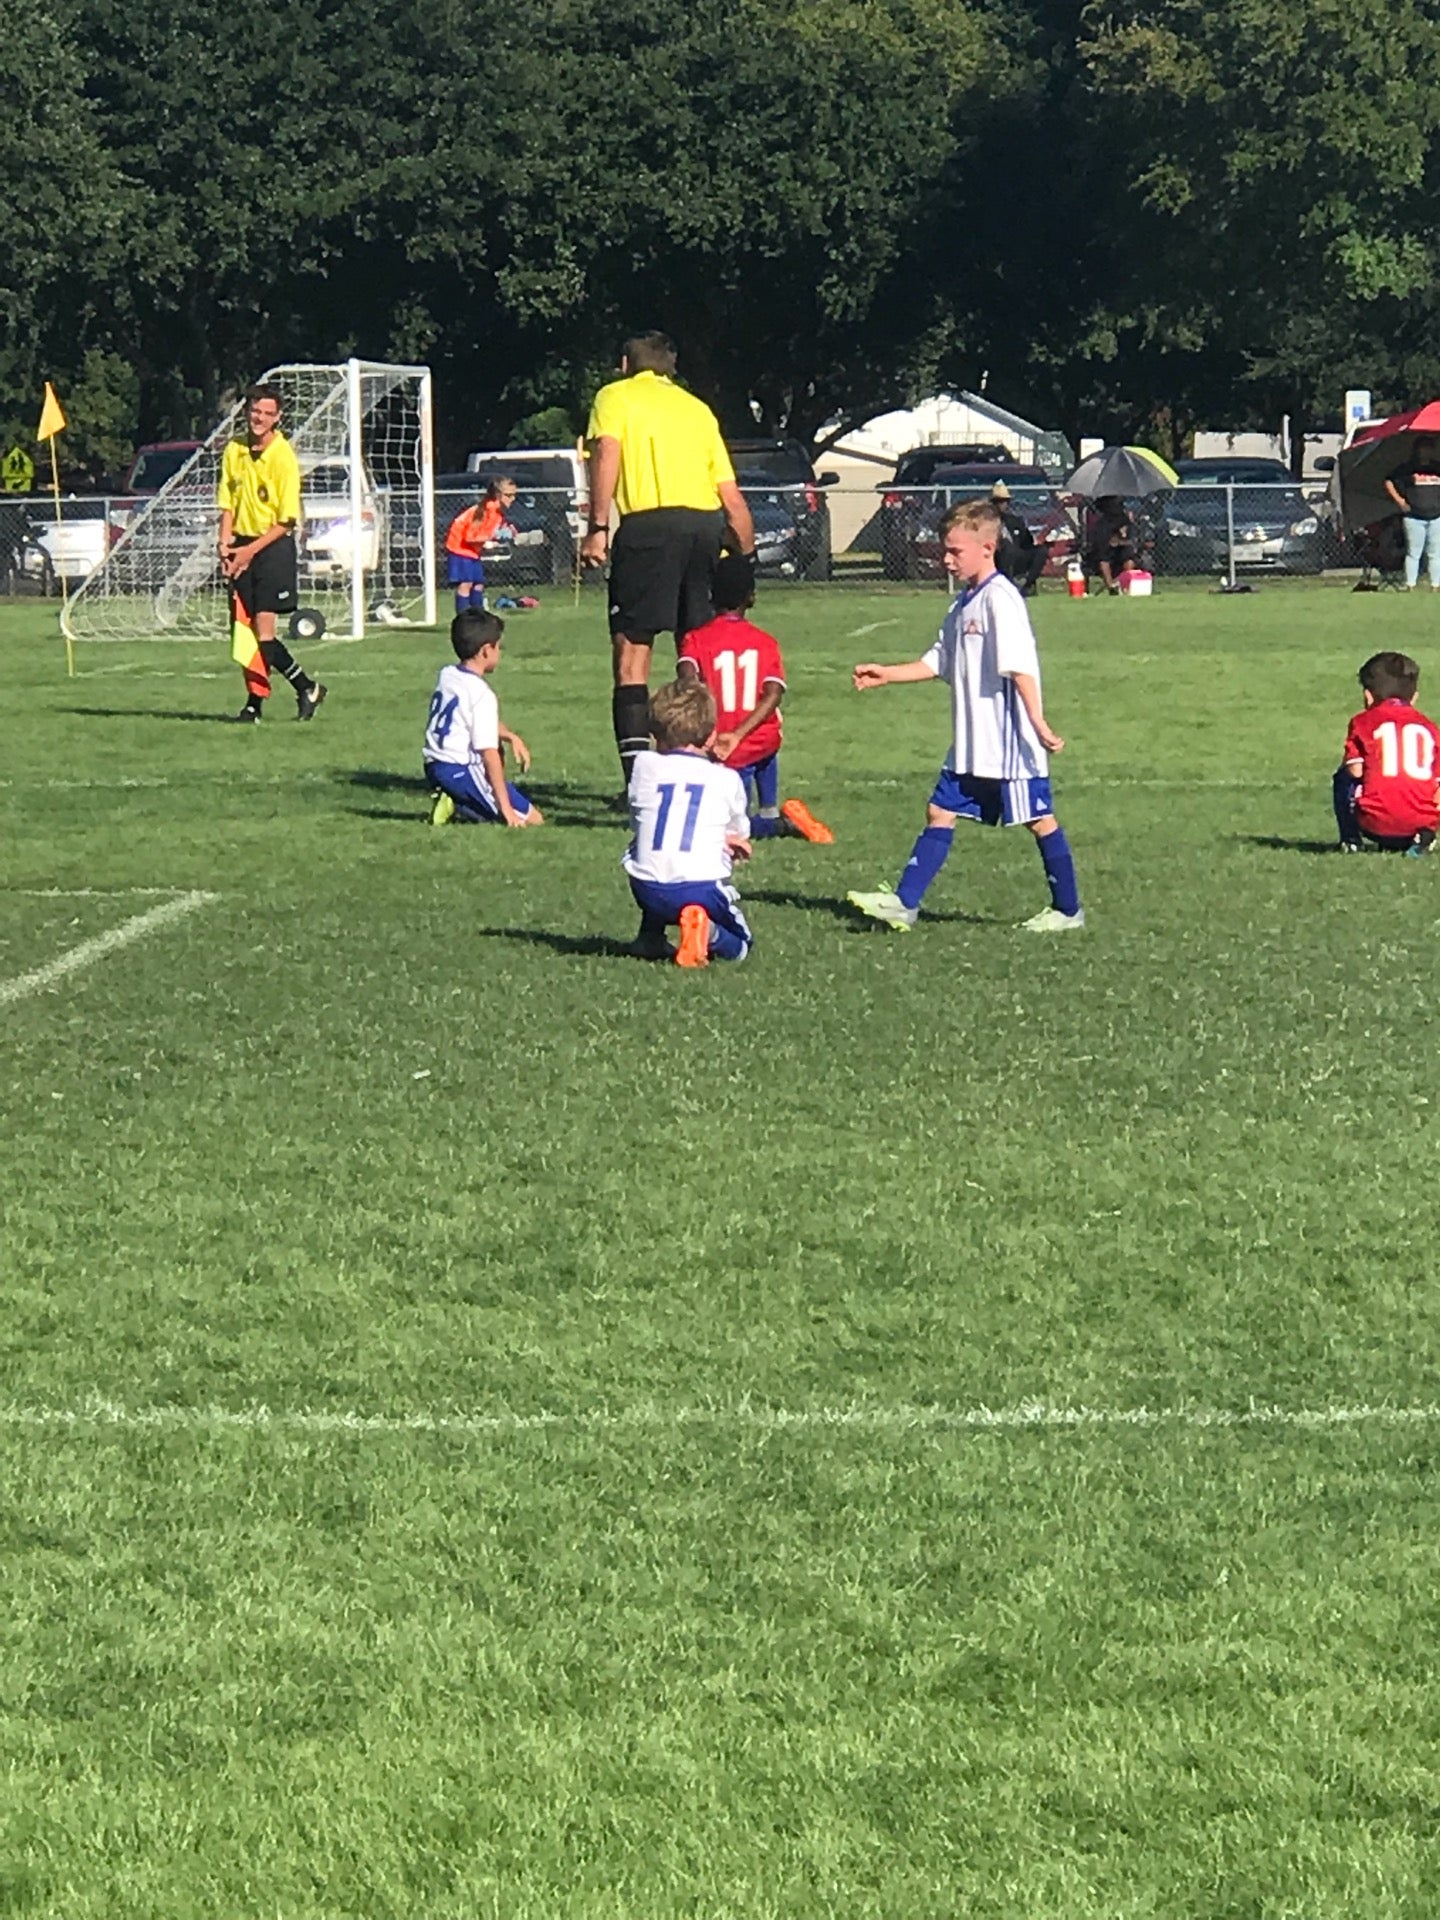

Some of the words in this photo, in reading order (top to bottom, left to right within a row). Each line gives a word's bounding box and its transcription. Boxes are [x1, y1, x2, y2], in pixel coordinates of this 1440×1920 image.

[714, 649, 758, 712] 11
[1373, 721, 1435, 780] 10
[652, 783, 705, 852] 11
